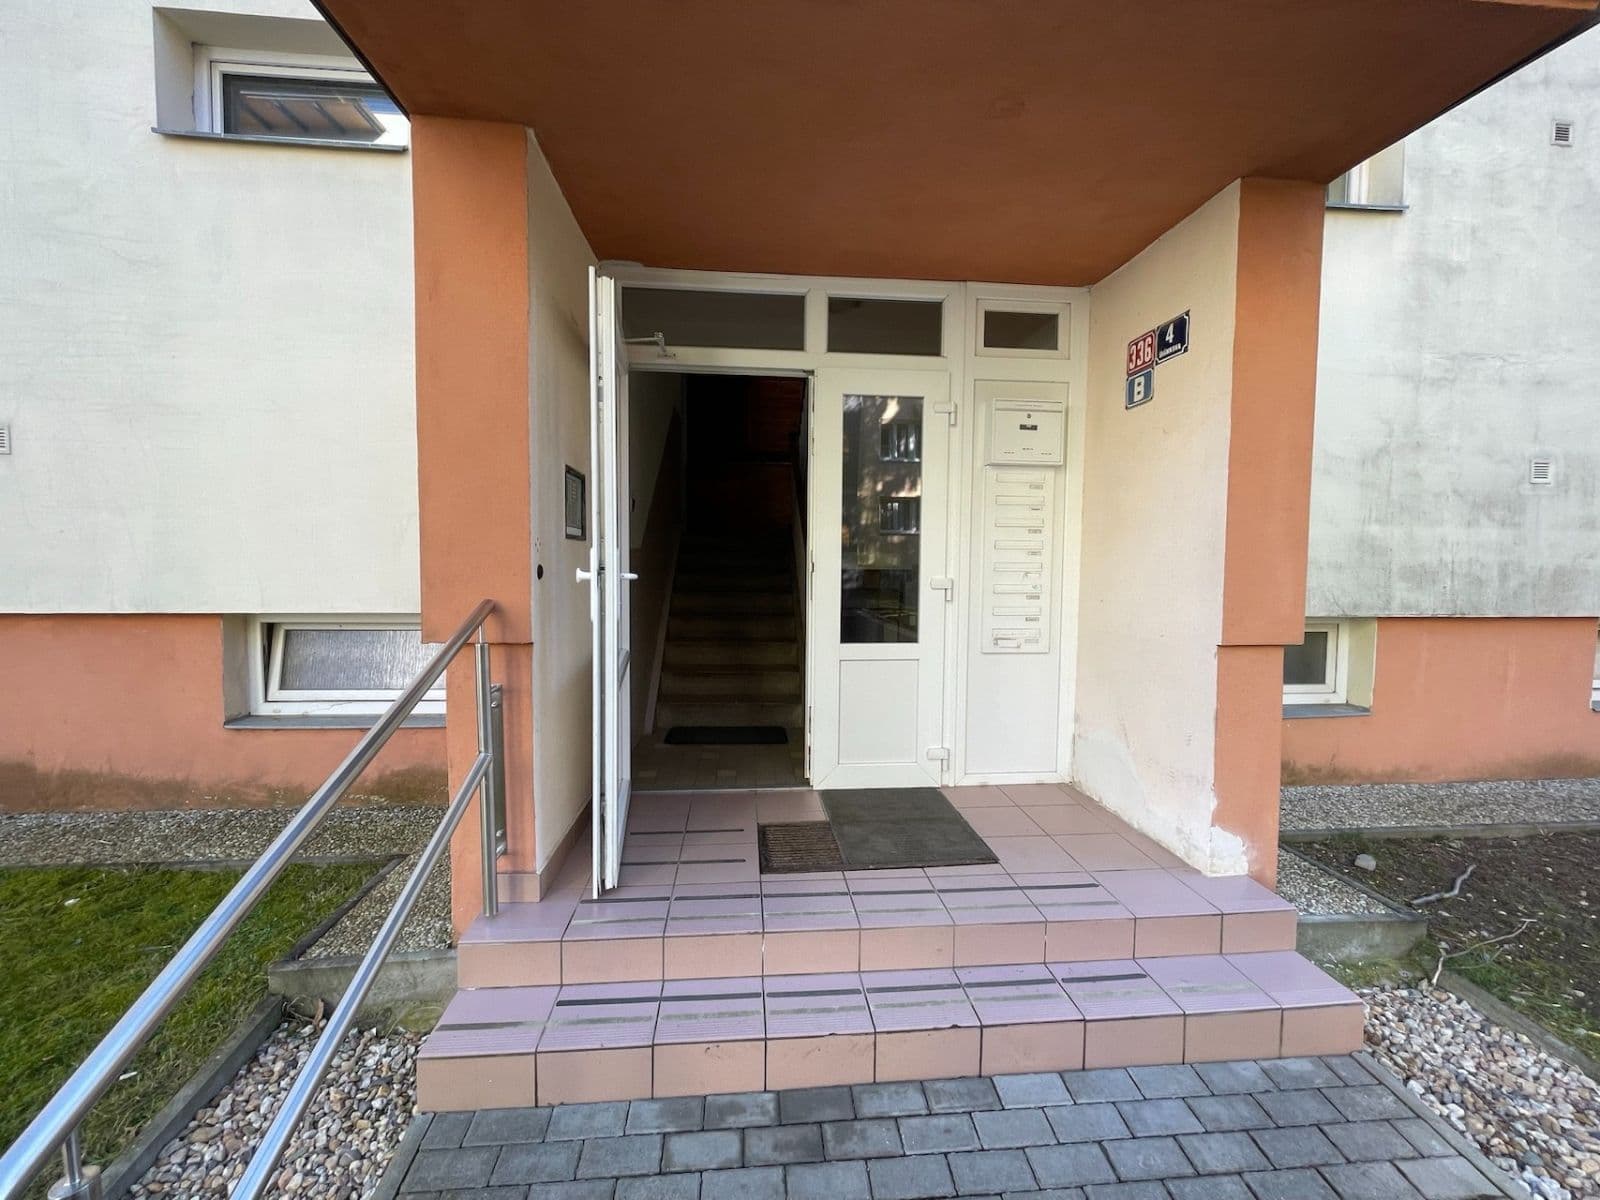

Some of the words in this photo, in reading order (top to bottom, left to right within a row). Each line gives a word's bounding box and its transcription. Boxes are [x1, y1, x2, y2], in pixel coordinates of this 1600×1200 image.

[1165, 322, 1175, 343] 4
[1129, 336, 1152, 370] 336
[1134, 375, 1145, 402] B
